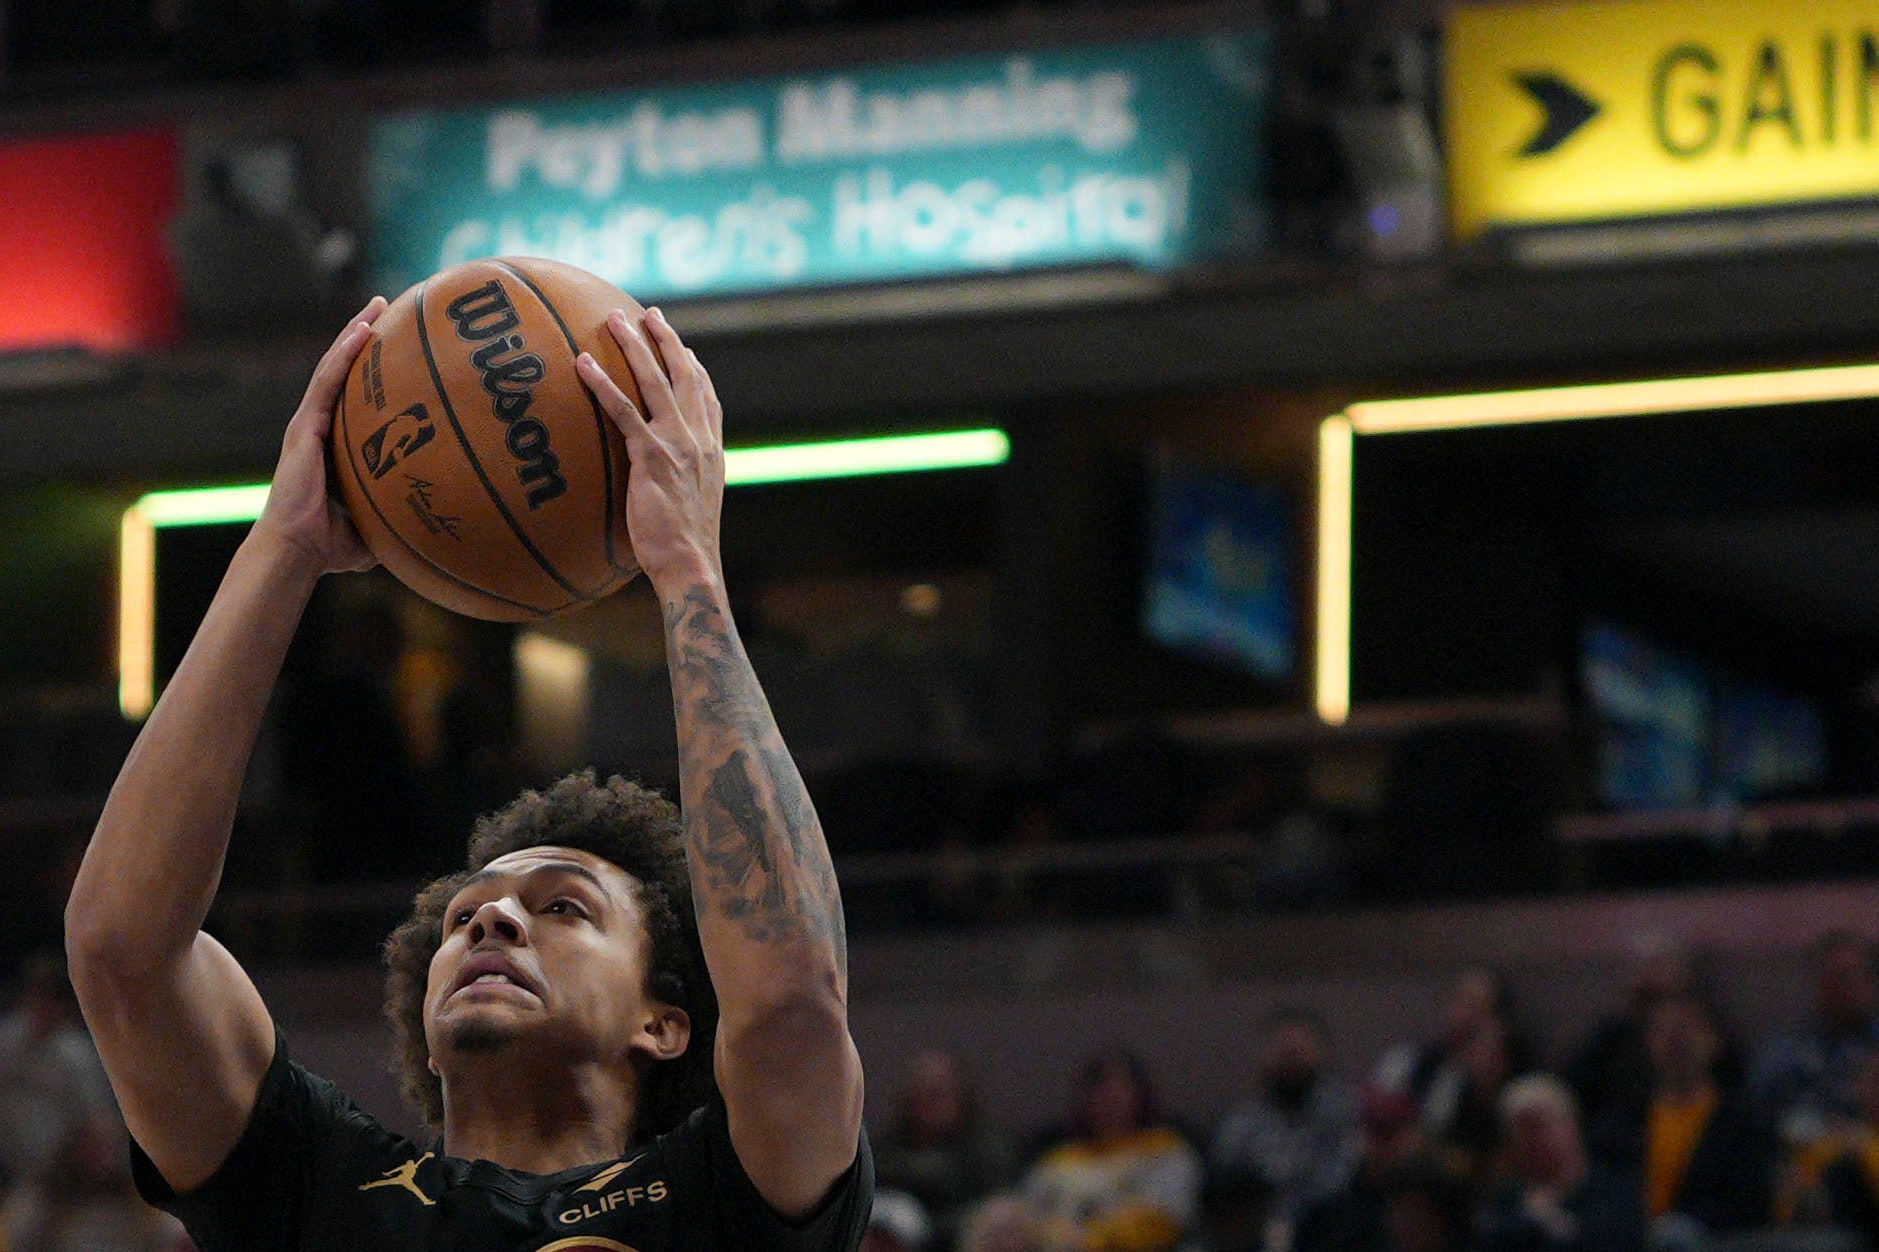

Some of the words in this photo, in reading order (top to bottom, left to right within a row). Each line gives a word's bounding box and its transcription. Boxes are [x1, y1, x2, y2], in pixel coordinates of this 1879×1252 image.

[486, 100, 764, 196] Peyton
[774, 58, 1137, 158] Manning
[833, 154, 1191, 266] Hospital
[446, 279, 568, 512] Wilson
[559, 1180, 668, 1224] CLIFFS
